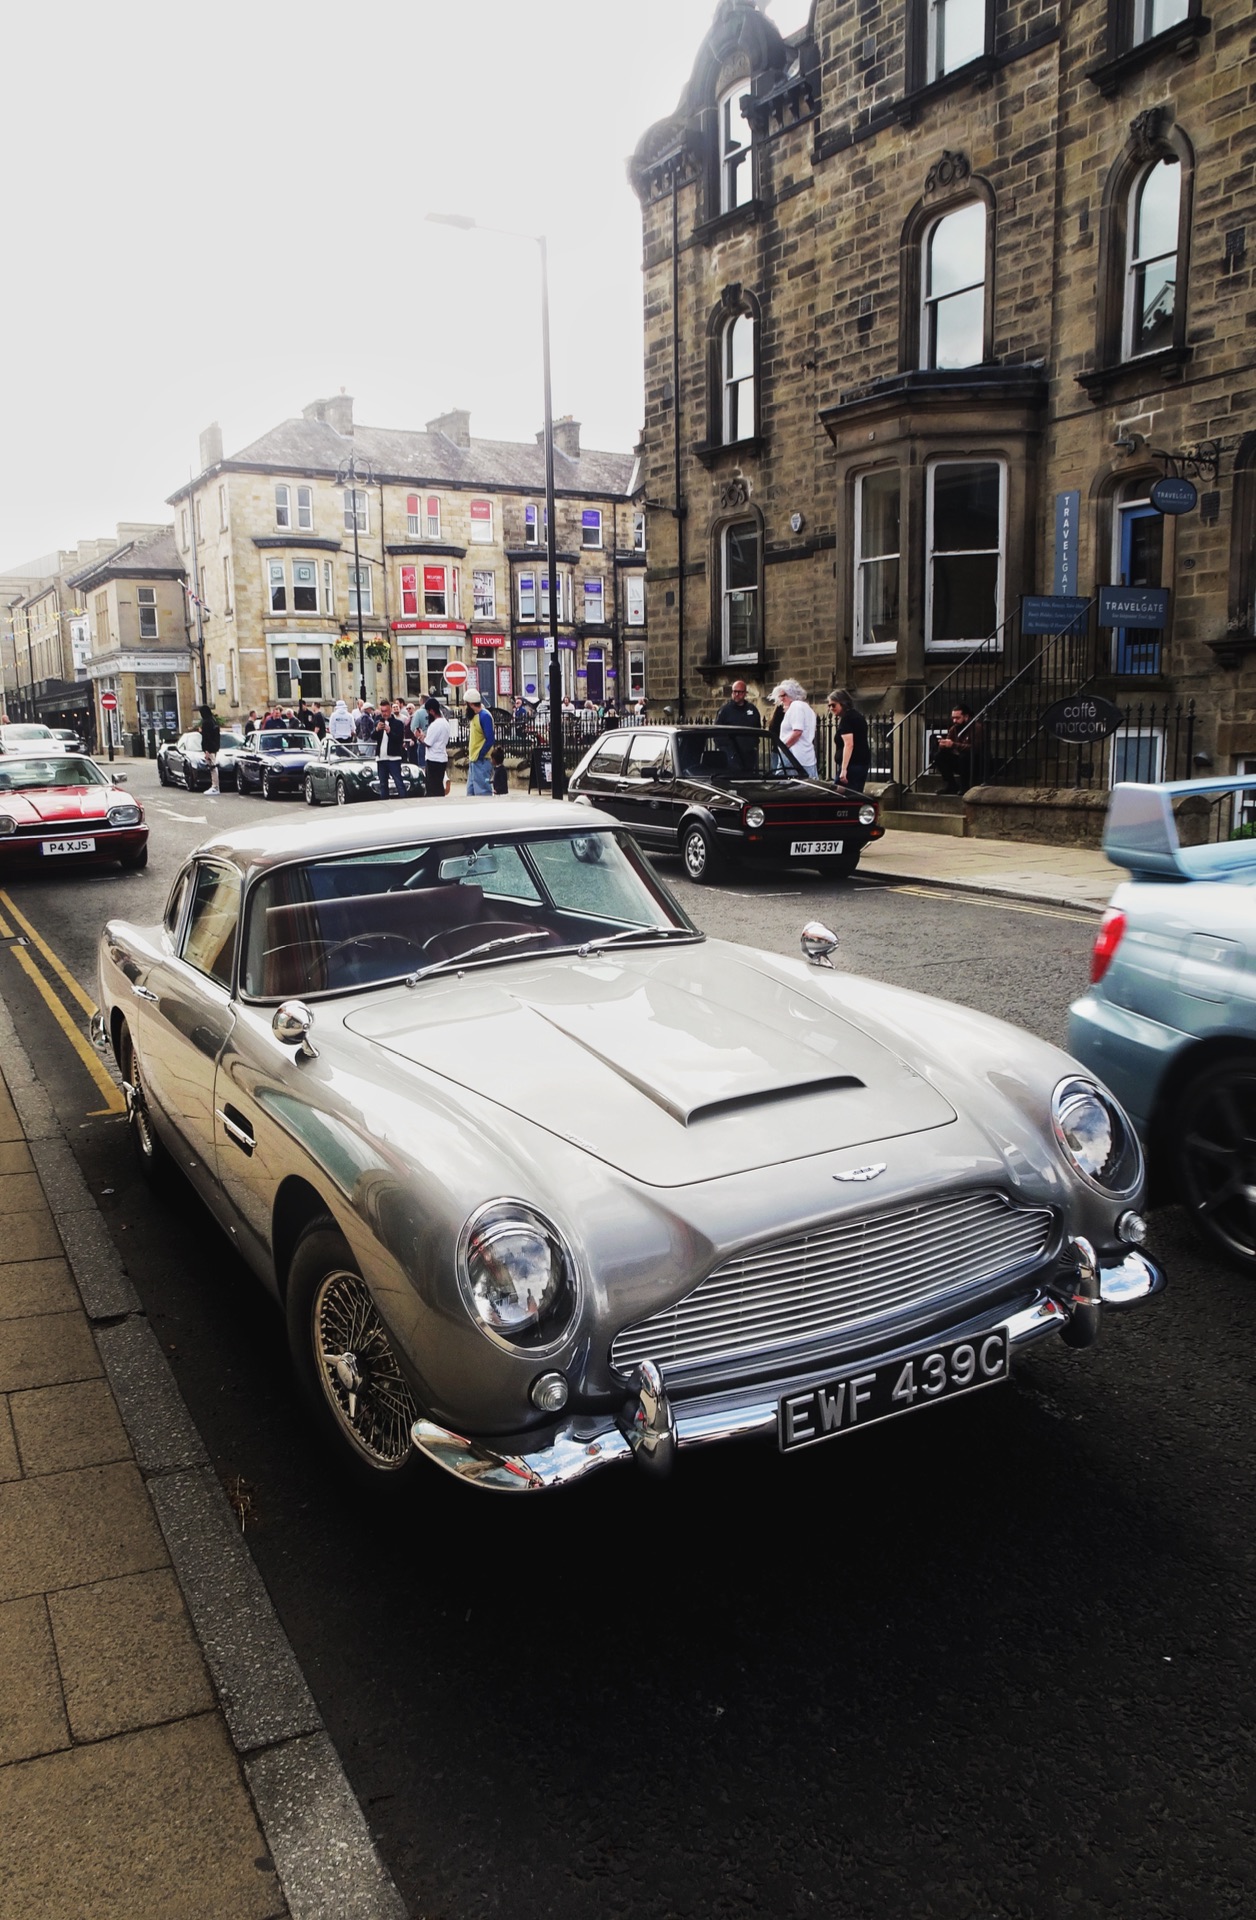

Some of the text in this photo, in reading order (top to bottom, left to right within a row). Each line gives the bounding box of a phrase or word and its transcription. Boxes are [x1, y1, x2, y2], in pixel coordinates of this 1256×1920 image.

[1157, 491, 1193, 500] TRAVELGATE
[1061, 496, 1070, 593] TRAVELGAT
[1105, 601, 1164, 613] TRAVELGATE
[1063, 701, 1097, 718] caffè
[1055, 718, 1107, 733] marconi
[49, 840, 89, 852] P4 XJS
[794, 841, 839, 853] NGT 333Y
[786, 1335, 1004, 1443] EWF 439C
